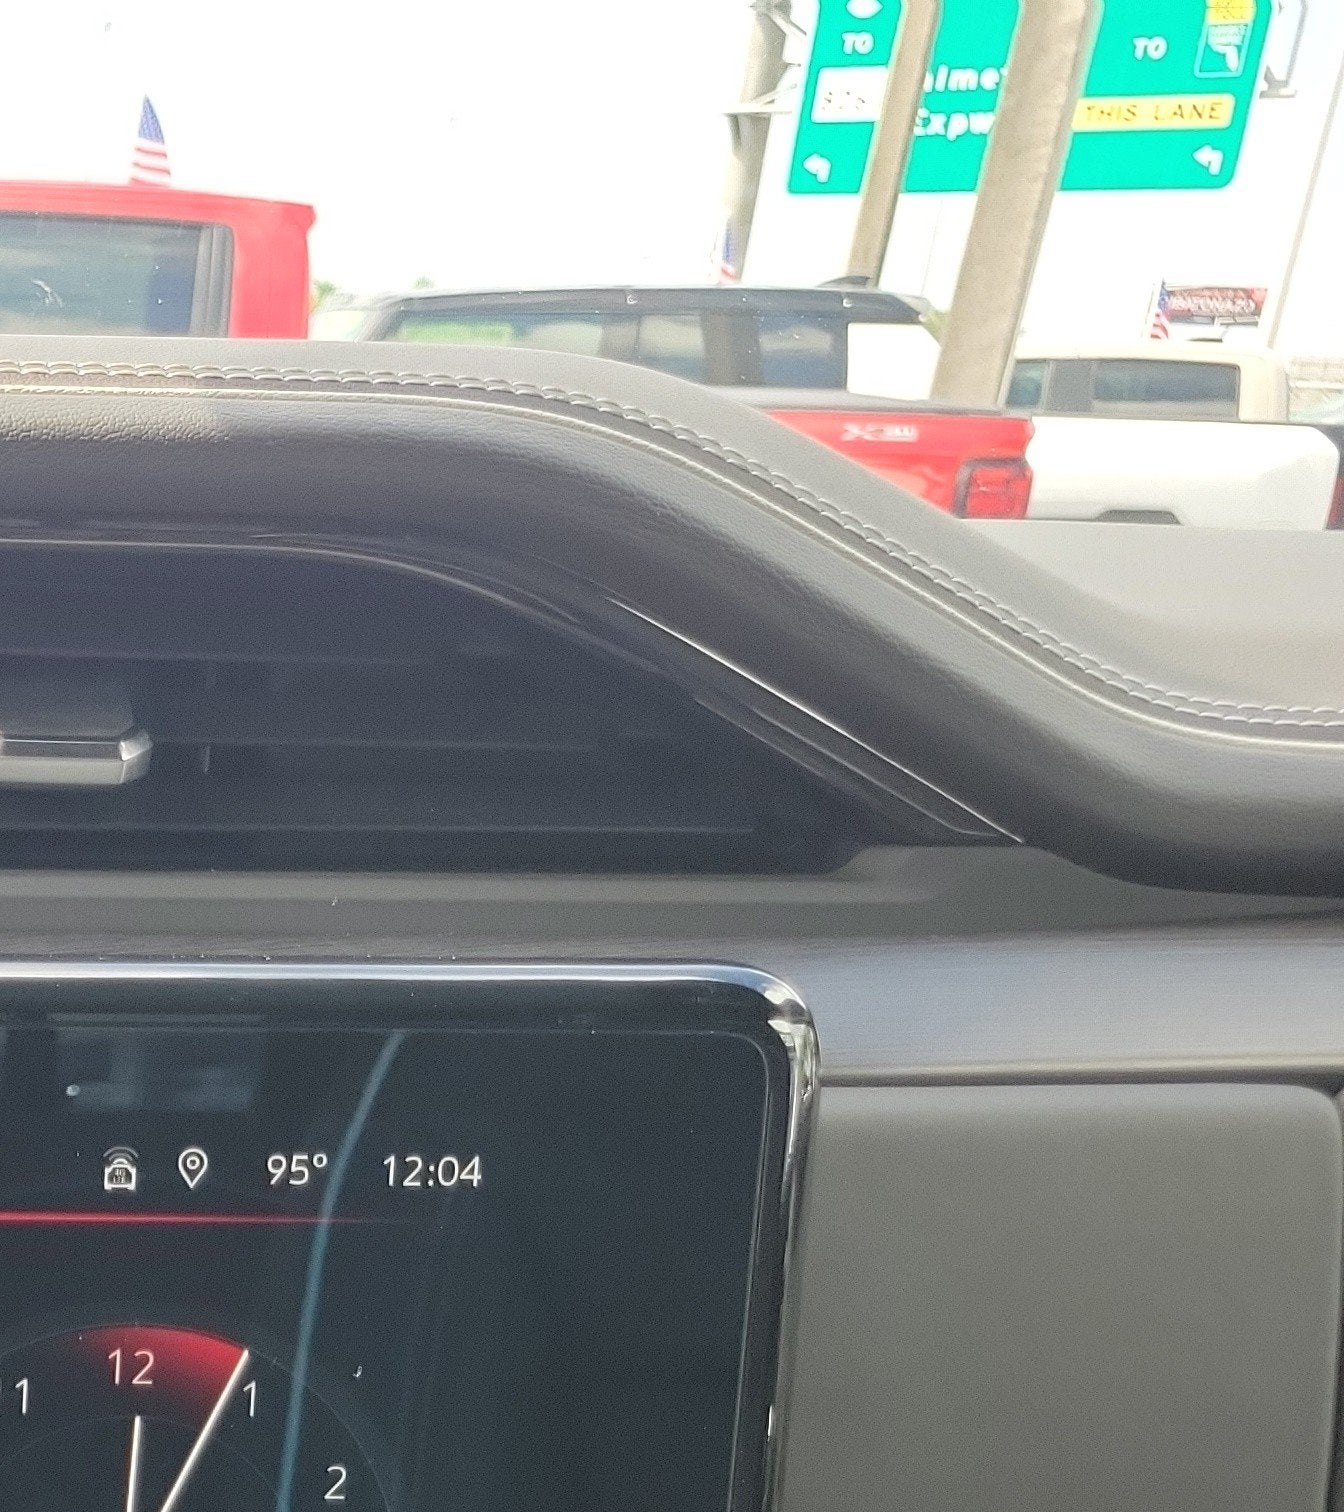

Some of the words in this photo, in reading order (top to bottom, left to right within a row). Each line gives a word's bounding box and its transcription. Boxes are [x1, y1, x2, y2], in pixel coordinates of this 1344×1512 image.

[841, 31, 874, 55] TO
[1132, 36, 1168, 60] TO
[1153, 102, 1223, 121] LANE
[383, 1155, 482, 1188] 12:04
[108, 1348, 155, 1385] 12
[243, 1380, 256, 1417] 1
[323, 1465, 347, 1500] 2
